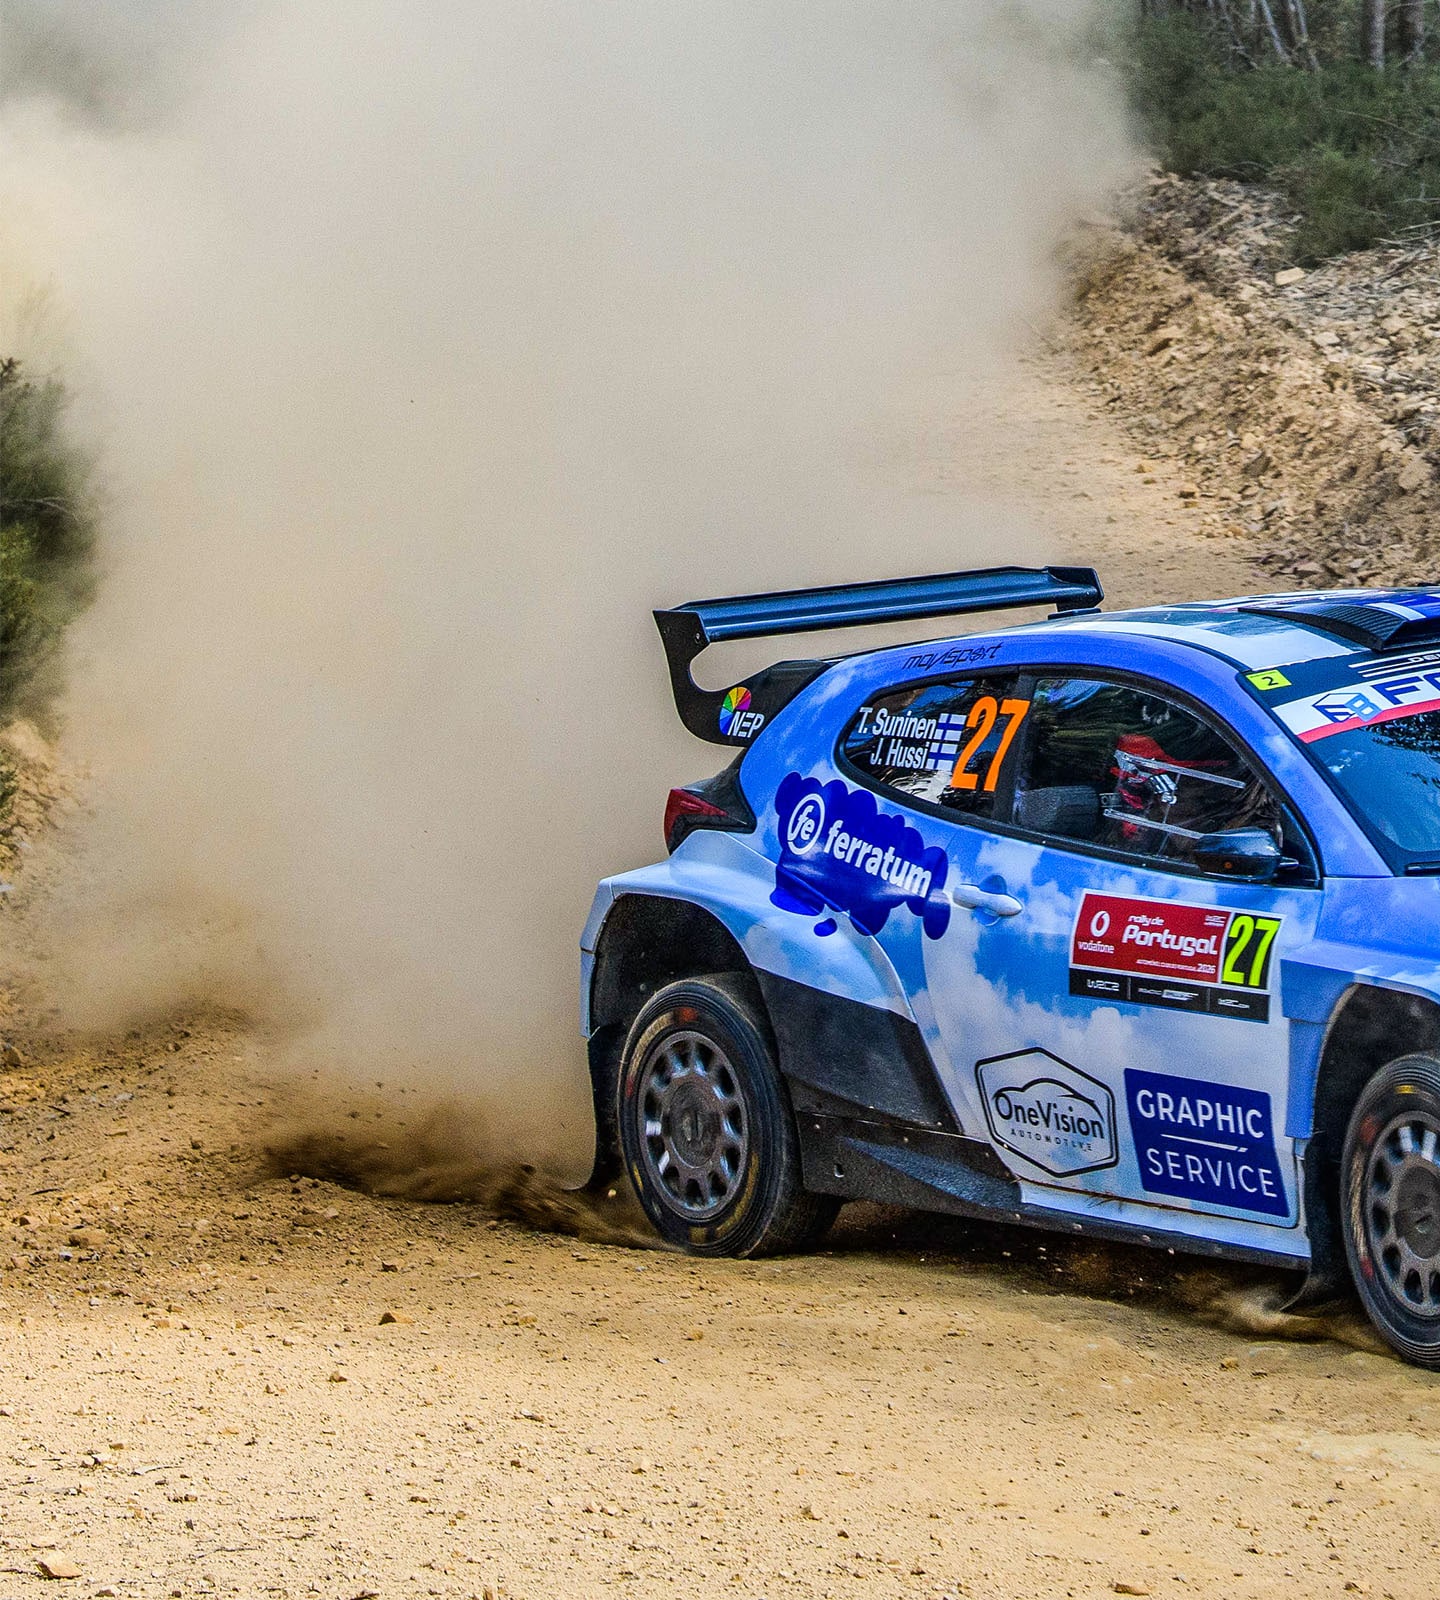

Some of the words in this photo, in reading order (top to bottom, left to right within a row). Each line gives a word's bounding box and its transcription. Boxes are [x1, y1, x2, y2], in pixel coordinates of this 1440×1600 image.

[727, 711, 764, 738] NEP
[858, 706, 873, 734] T.
[872, 707, 937, 740] Suninen
[870, 737, 883, 765] J.
[885, 739, 930, 769] Hussi
[951, 696, 1031, 792] 27
[824, 819, 933, 898] ferratum
[1128, 914, 1150, 926] rally
[1078, 940, 1115, 954] vodafone
[1122, 924, 1218, 957] Portugal
[1222, 915, 1280, 987] 27
[995, 1092, 1105, 1139] OneVision
[1136, 1089, 1264, 1138] GRAPHIC
[1146, 1148, 1277, 1198] SERVICE
